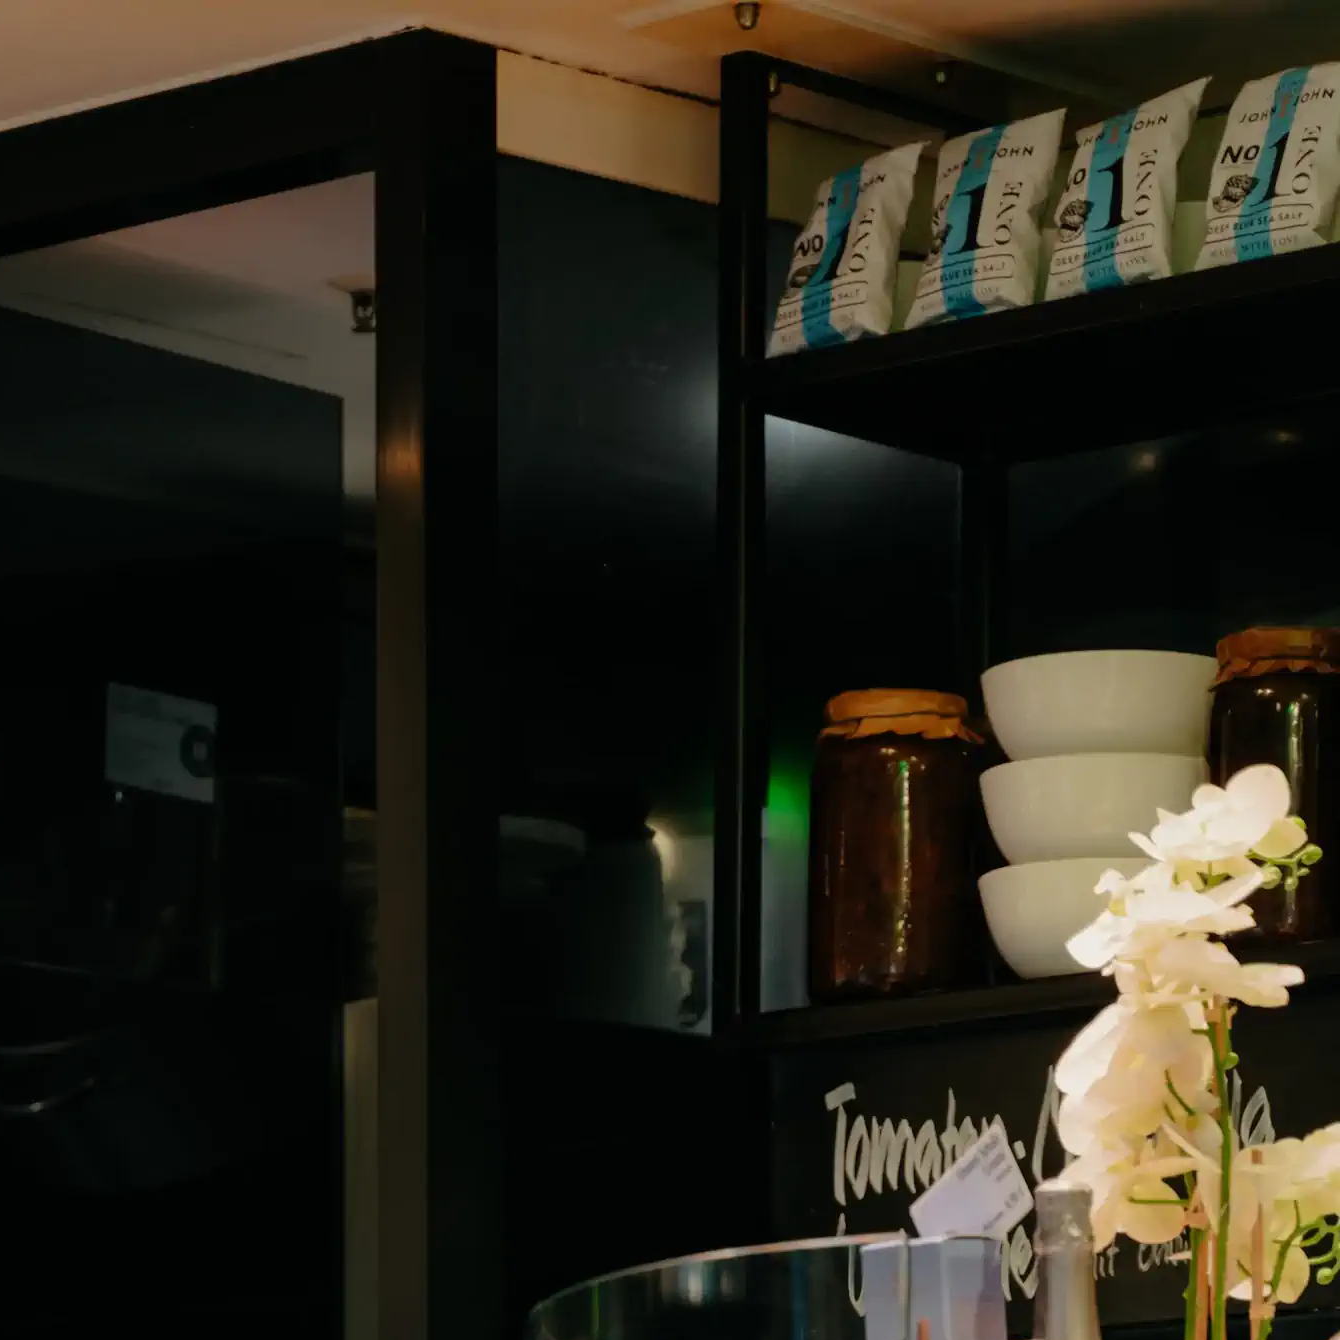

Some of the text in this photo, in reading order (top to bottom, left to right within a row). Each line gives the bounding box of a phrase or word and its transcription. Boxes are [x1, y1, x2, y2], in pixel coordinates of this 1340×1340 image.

[1294, 88, 1334, 109] JOHN
[1134, 148, 1158, 217] ONE
[1220, 144, 1260, 166] NO
[1291, 124, 1323, 196] ONE
[994, 182, 1023, 247] ONE
